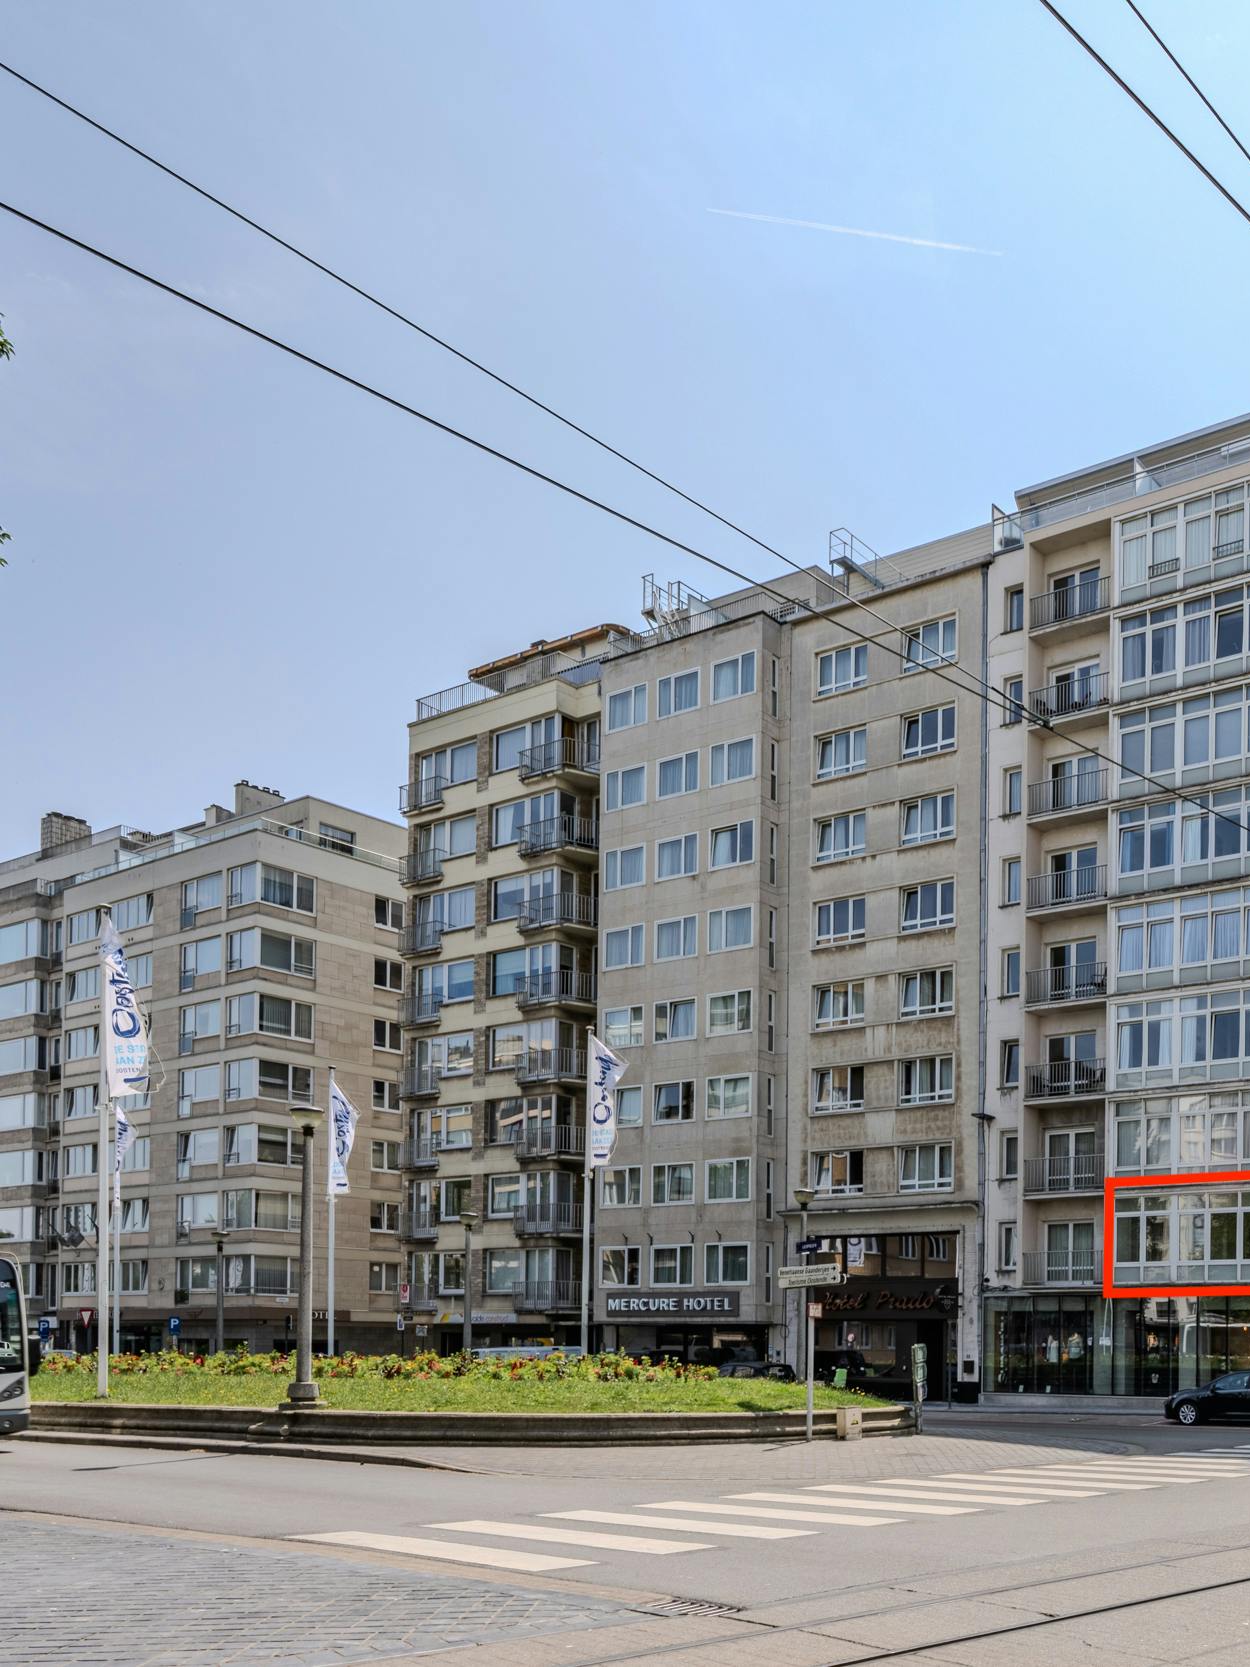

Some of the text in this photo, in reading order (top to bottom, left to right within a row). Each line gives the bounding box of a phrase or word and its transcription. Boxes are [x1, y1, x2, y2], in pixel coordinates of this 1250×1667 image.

[607, 1297, 733, 1311] MERCURE HOTEL
[825, 1291, 935, 1310] Hotel Prado
[40, 1322, 48, 1332] P
[170, 1318, 179, 1329] P
